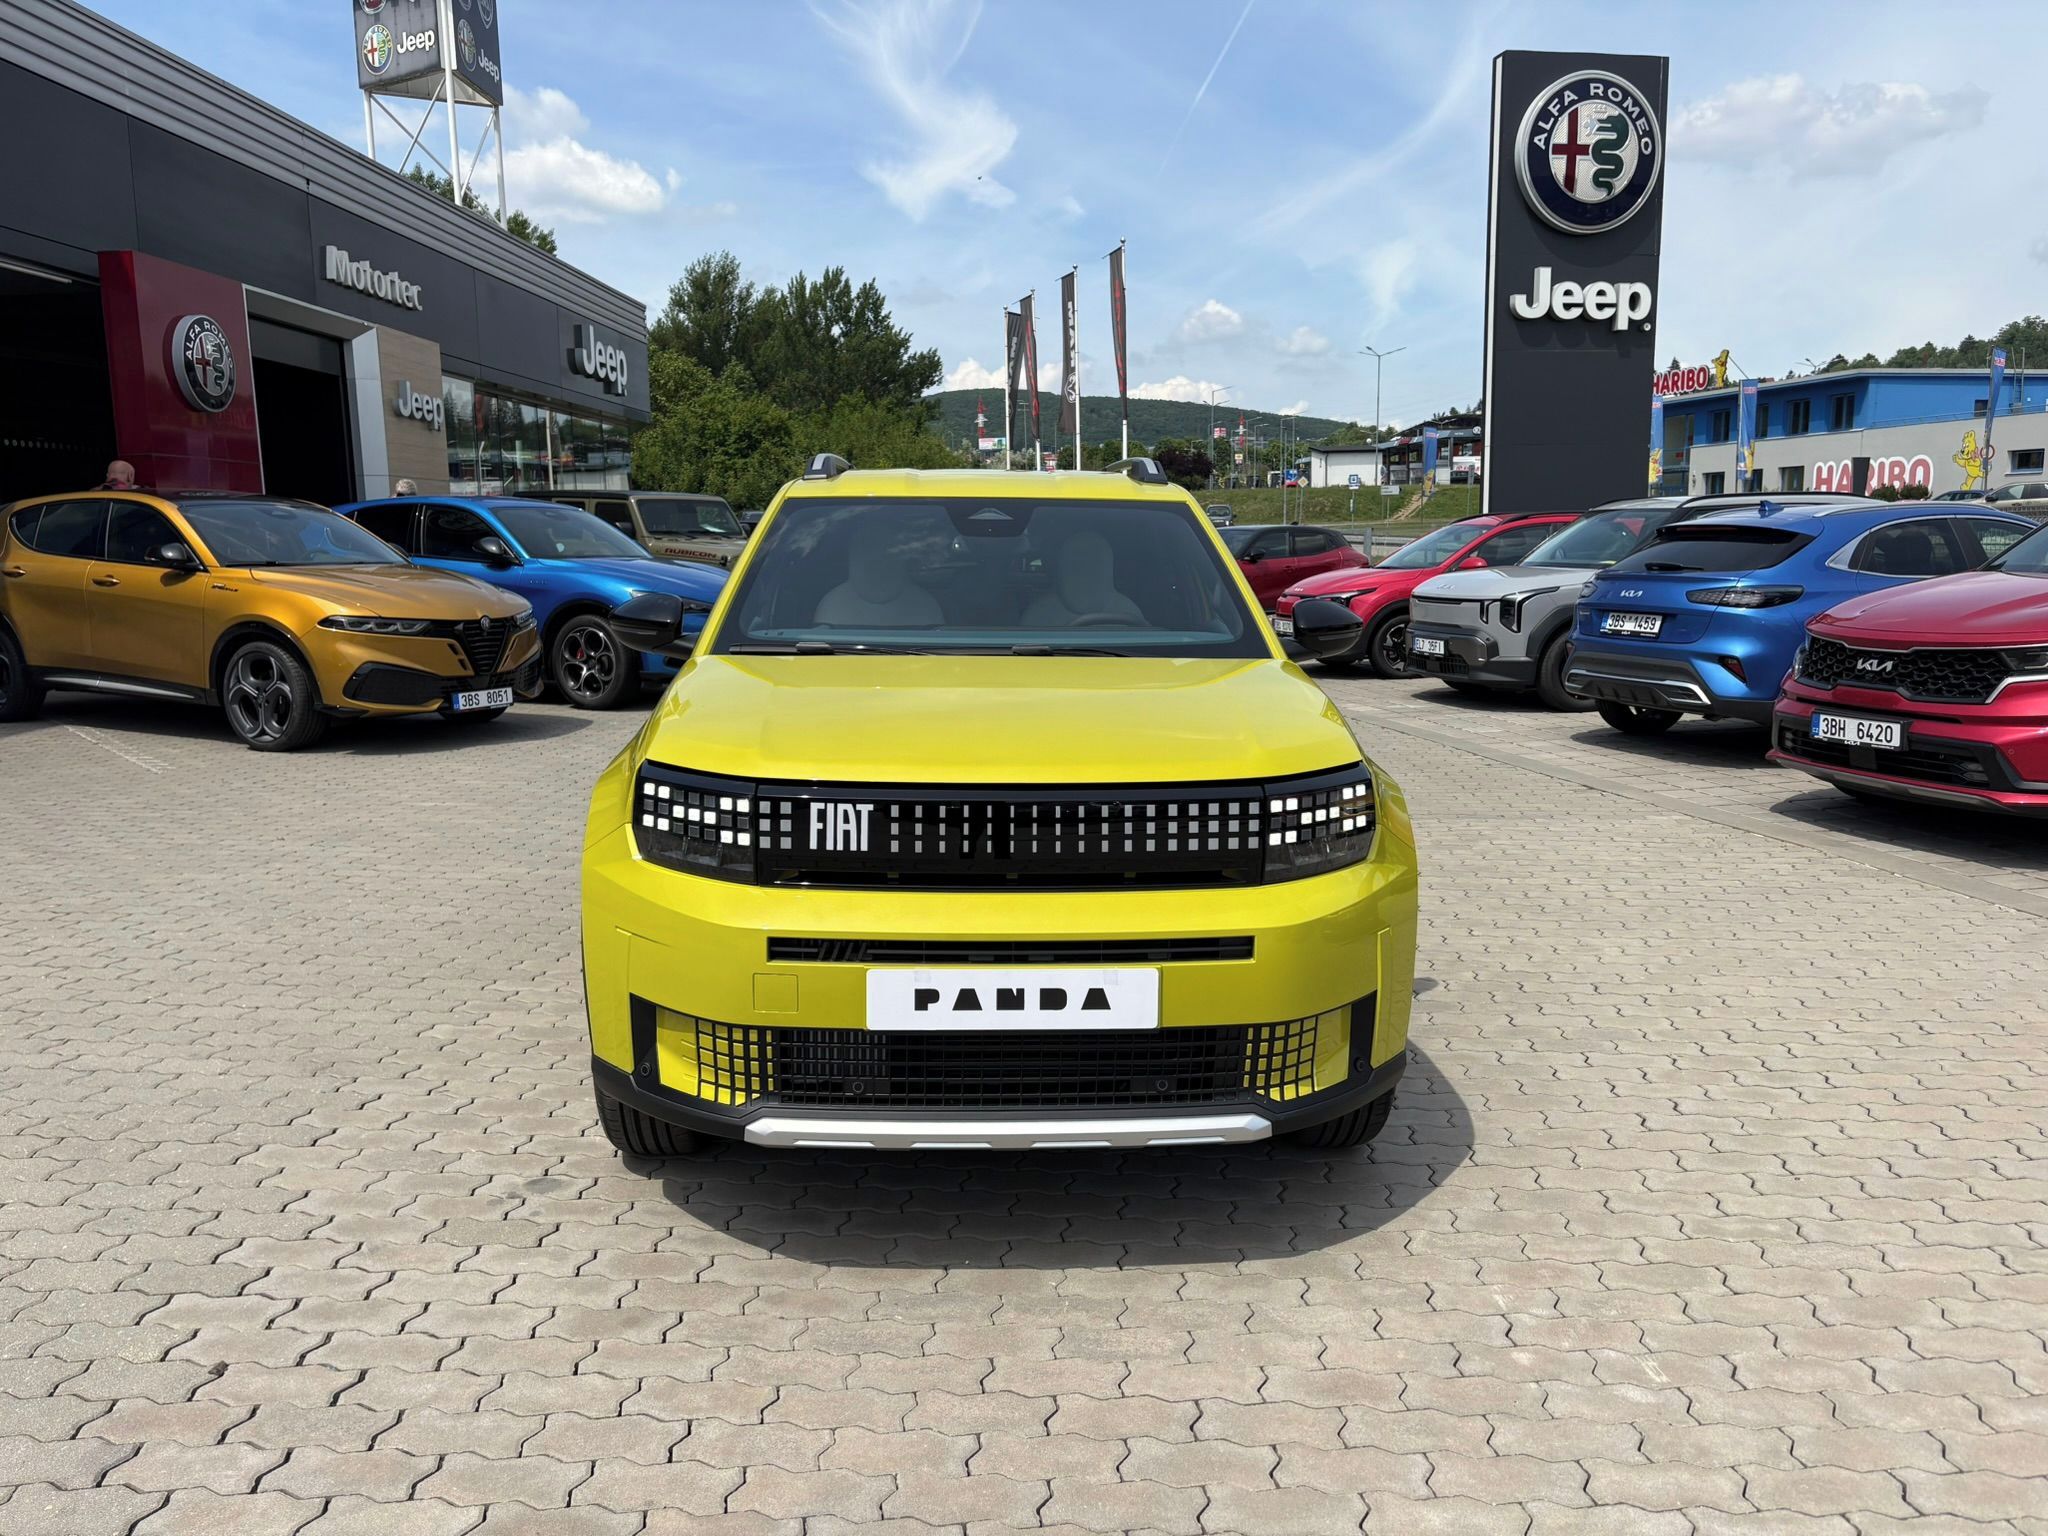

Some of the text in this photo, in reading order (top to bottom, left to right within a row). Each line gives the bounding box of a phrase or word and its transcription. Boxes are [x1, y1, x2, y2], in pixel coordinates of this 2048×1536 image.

[396, 30, 435, 54] Jeep
[478, 49, 500, 82] Jeep
[1533, 83, 1653, 156] ALFA ROMEO
[325, 245, 423, 311] Motortec
[1509, 266, 1652, 332] Jeep
[185, 320, 233, 369] ALFA ROMEO
[582, 324, 628, 396] Jeep
[397, 381, 444, 430] Jeep
[664, 547, 718, 559] RUBICON
[1608, 614, 1657, 631] 3BS 1459
[1856, 658, 1893, 672] KIA
[461, 690, 509, 708] 3BS 8051
[1822, 717, 1894, 743] 3BH 6420
[809, 802, 874, 852] FIAT
[914, 988, 1111, 1011] PANDA
